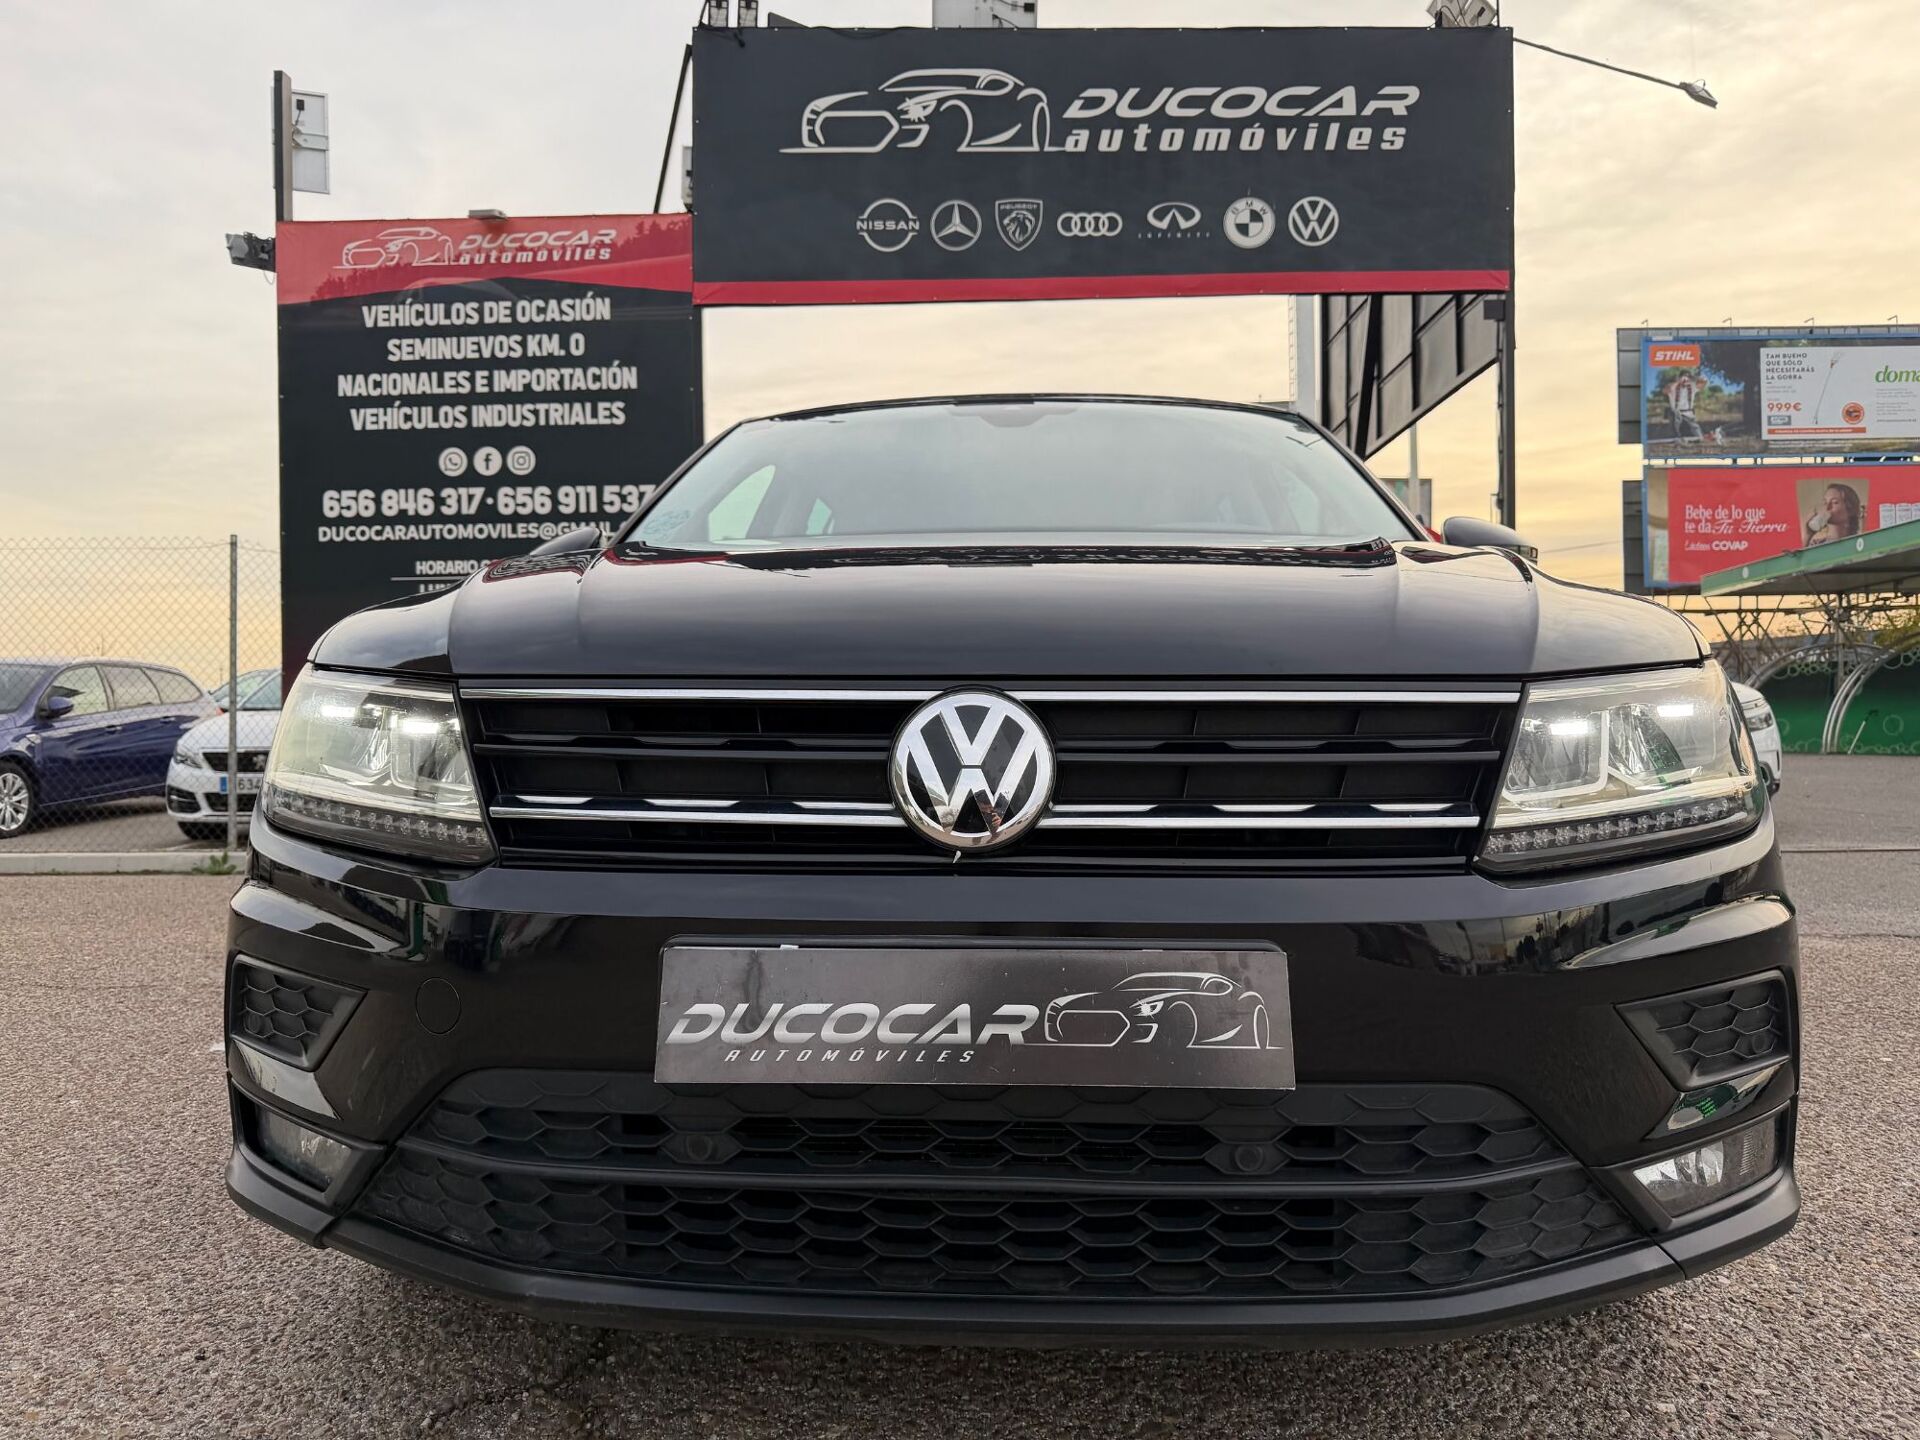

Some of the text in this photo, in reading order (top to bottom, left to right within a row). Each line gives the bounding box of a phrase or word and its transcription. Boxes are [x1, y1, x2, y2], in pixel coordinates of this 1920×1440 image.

[1062, 85, 1420, 119] DUCOCAR
[1065, 122, 1407, 152] automóviles
[856, 218, 920, 231] NISSAN
[459, 229, 617, 249] DUCOCAR
[362, 291, 612, 328] VEHÍCULOS DE OCASIÓN
[387, 334, 522, 362] SEMINUEVOS
[527, 334, 566, 357] KM.
[1654, 350, 1695, 361] STIHL
[337, 360, 638, 397] NACIONALES E IMPORTACIÓN
[350, 402, 626, 431] VEHÍCULOS INDUSTRIALES
[1767, 402, 1802, 412] 999€
[322, 490, 376, 518] 656
[380, 489, 435, 517] 846
[557, 485, 597, 513] 911
[602, 484, 657, 513] 537
[1685, 504, 1766, 522] Bebe de lo que
[1684, 521, 1695, 533] te
[1697, 520, 1711, 533] da
[1738, 518, 1788, 533] Tierra
[1711, 540, 1748, 551] COVAP
[416, 560, 478, 575] HORARIO
[665, 1003, 1040, 1044] DUCOCAR
[724, 1047, 976, 1063] AUTOMÓVILES
